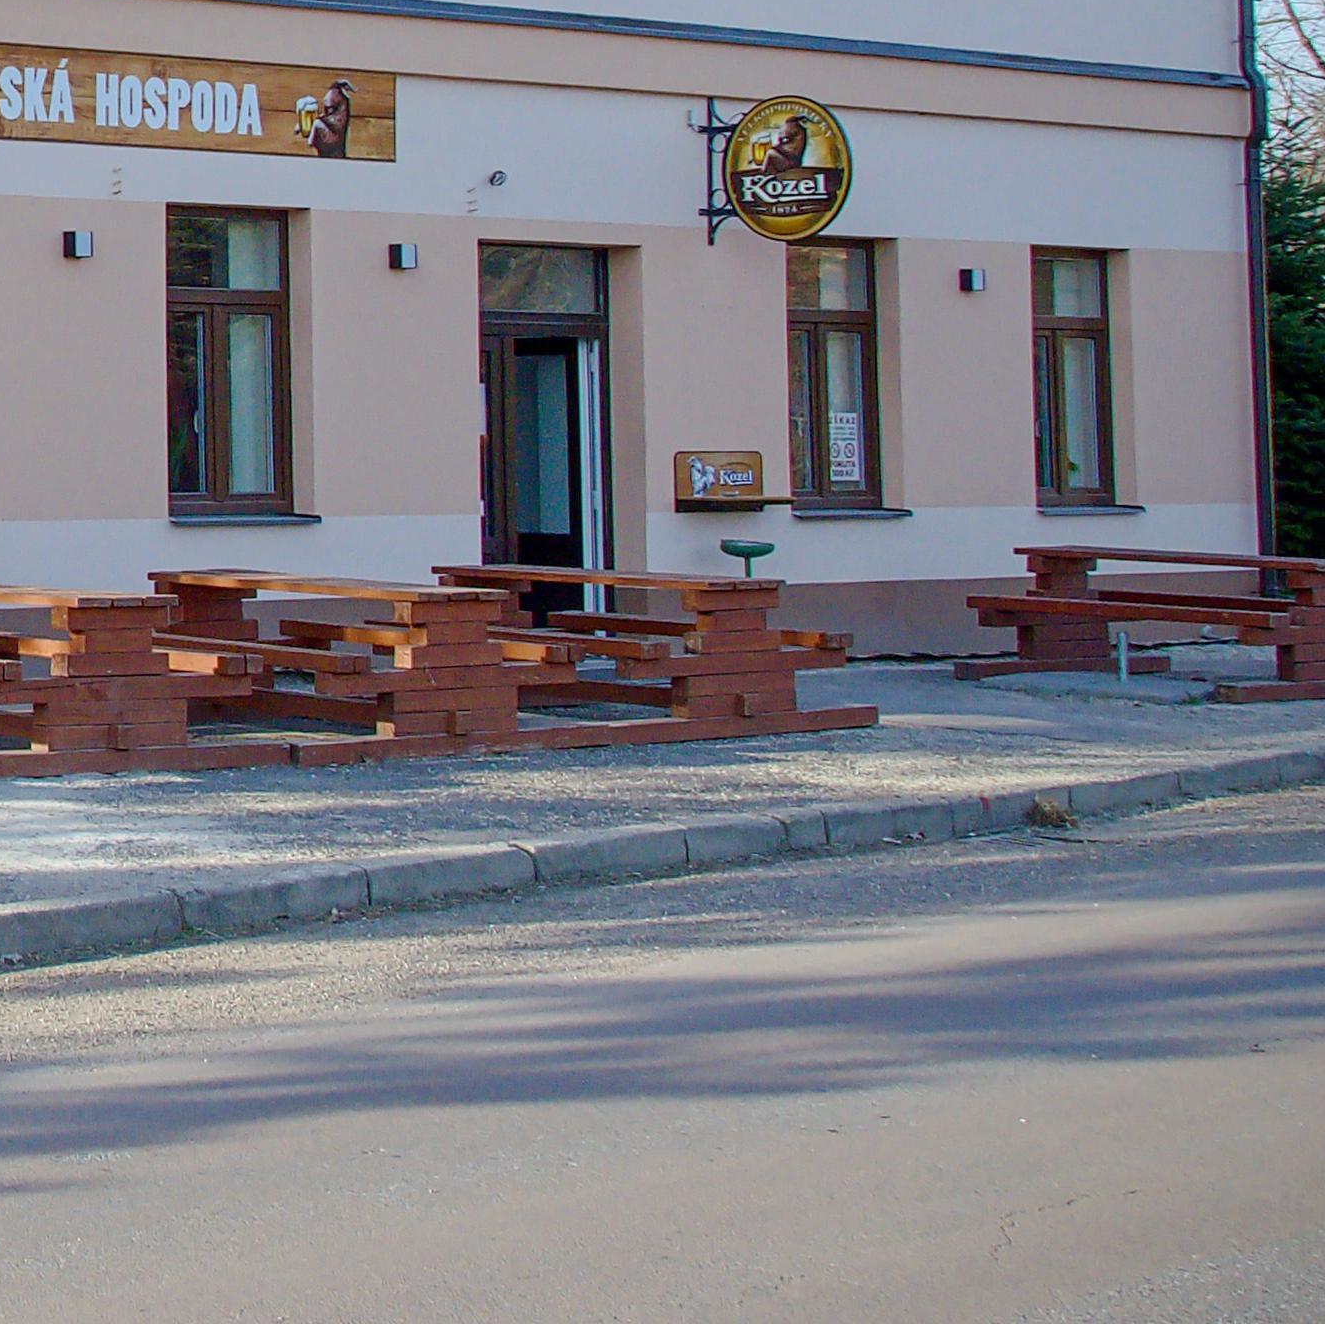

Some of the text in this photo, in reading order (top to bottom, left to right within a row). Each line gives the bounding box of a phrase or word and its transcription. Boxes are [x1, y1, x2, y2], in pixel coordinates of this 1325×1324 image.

[95, 72, 262, 136] HOSPODA
[740, 174, 828, 203] Kozel
[719, 469, 754, 485] Kozel
